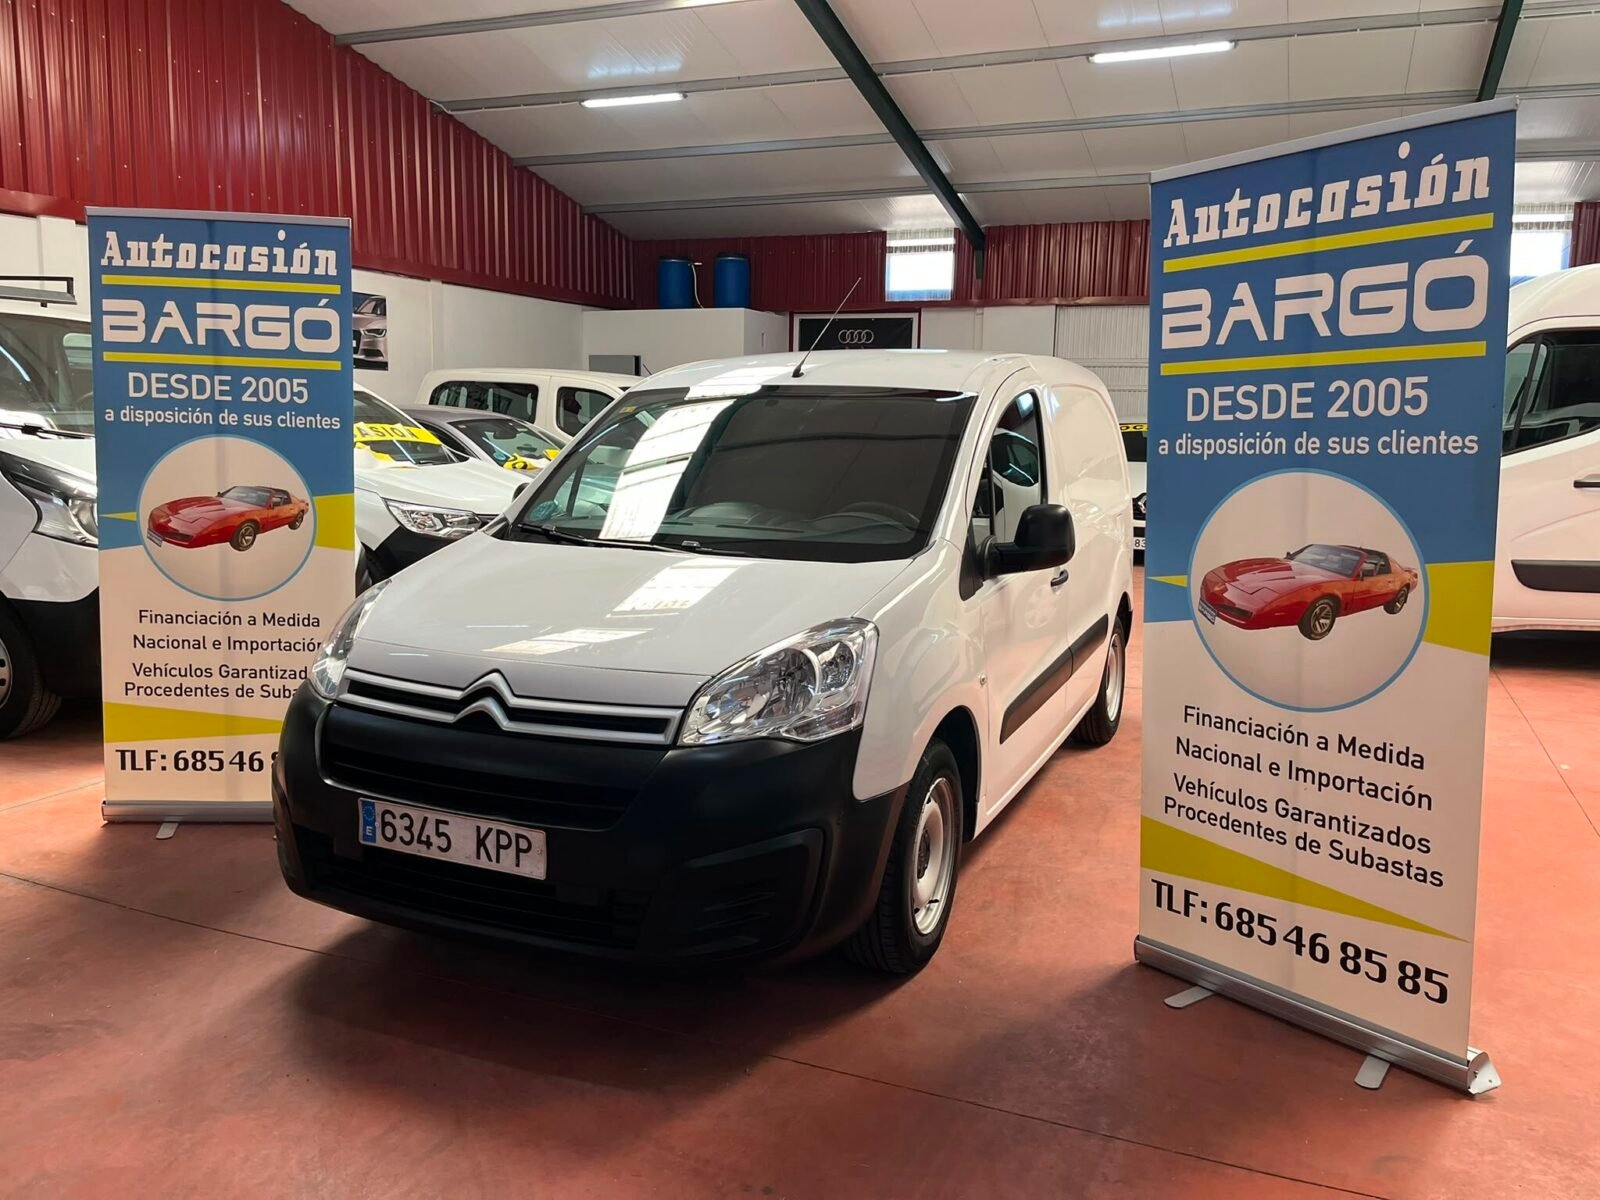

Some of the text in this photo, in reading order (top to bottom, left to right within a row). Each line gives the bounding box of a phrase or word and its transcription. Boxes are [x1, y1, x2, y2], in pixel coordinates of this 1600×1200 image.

[1162, 141, 1491, 248] Autocasión
[101, 229, 337, 275] Autocasión
[1161, 239, 1490, 350] BARGÓ
[102, 299, 341, 353] BARGÓ
[128, 372, 308, 404] DESDE 2005
[1186, 376, 1429, 422] DESDE 2005
[105, 406, 341, 429] a disposición de sus clientes
[1158, 430, 1479, 460] a disposición de sus clientes
[139, 610, 320, 627] Financiación a Medida
[133, 635, 207, 650] Nacional
[212, 639, 221, 650] e
[125, 682, 298, 699] Procedentes de Sub
[132, 663, 213, 678] Vehículos
[115, 750, 167, 771] TLF:
[173, 750, 224, 771] 685
[1184, 705, 1425, 770] Financiación a Medida
[1176, 737, 1432, 811] Nacional e Importación
[1173, 773, 1431, 854] Vehículos Garantizados
[366, 809, 532, 867] E 6345 KPP
[1164, 796, 1444, 888] Procedentes de Subastas
[1151, 879, 1207, 923] TLF:
[1215, 902, 1277, 946] 685
[1340, 941, 1388, 984] 85
[1397, 960, 1449, 1004] 85
